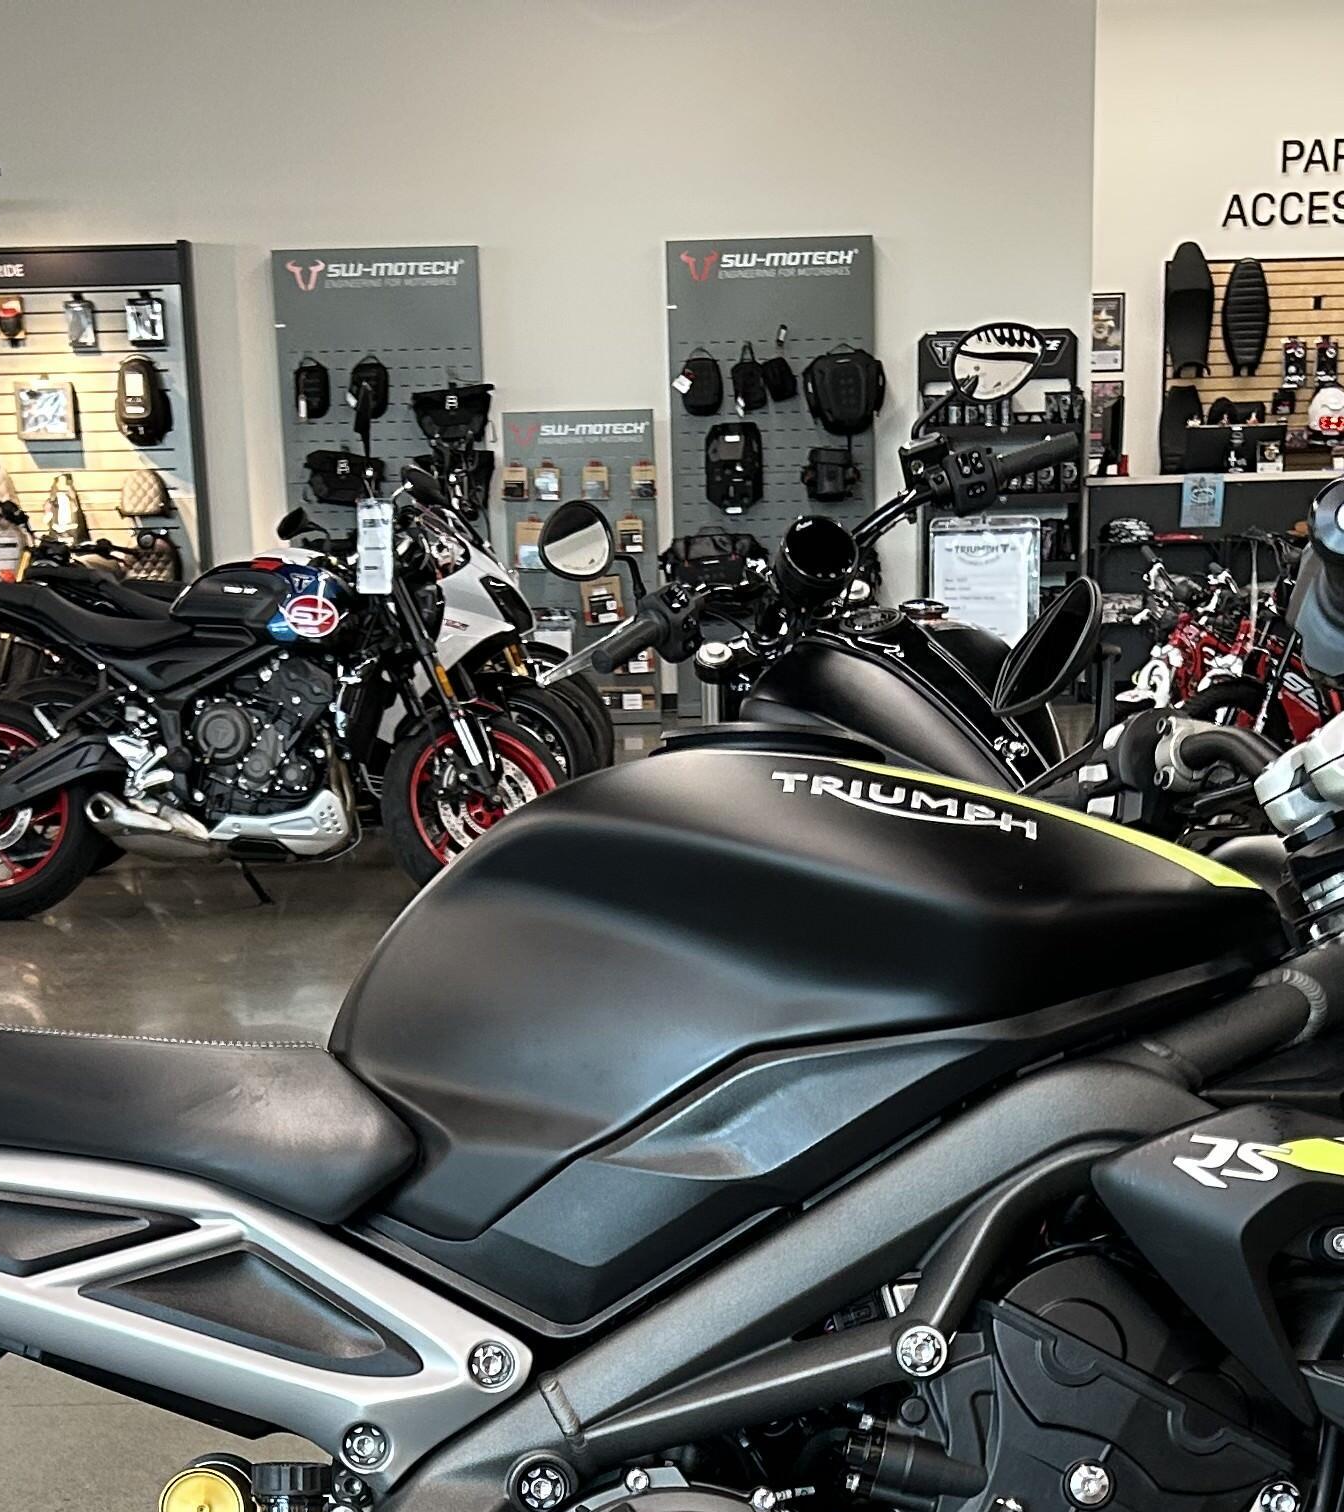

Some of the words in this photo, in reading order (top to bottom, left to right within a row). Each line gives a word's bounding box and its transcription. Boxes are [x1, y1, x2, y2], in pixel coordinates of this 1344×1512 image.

[954, 544, 999, 554] TRIUMPH
[771, 769, 1038, 842] TRIUMPH
[1172, 1133, 1294, 1190] RS
